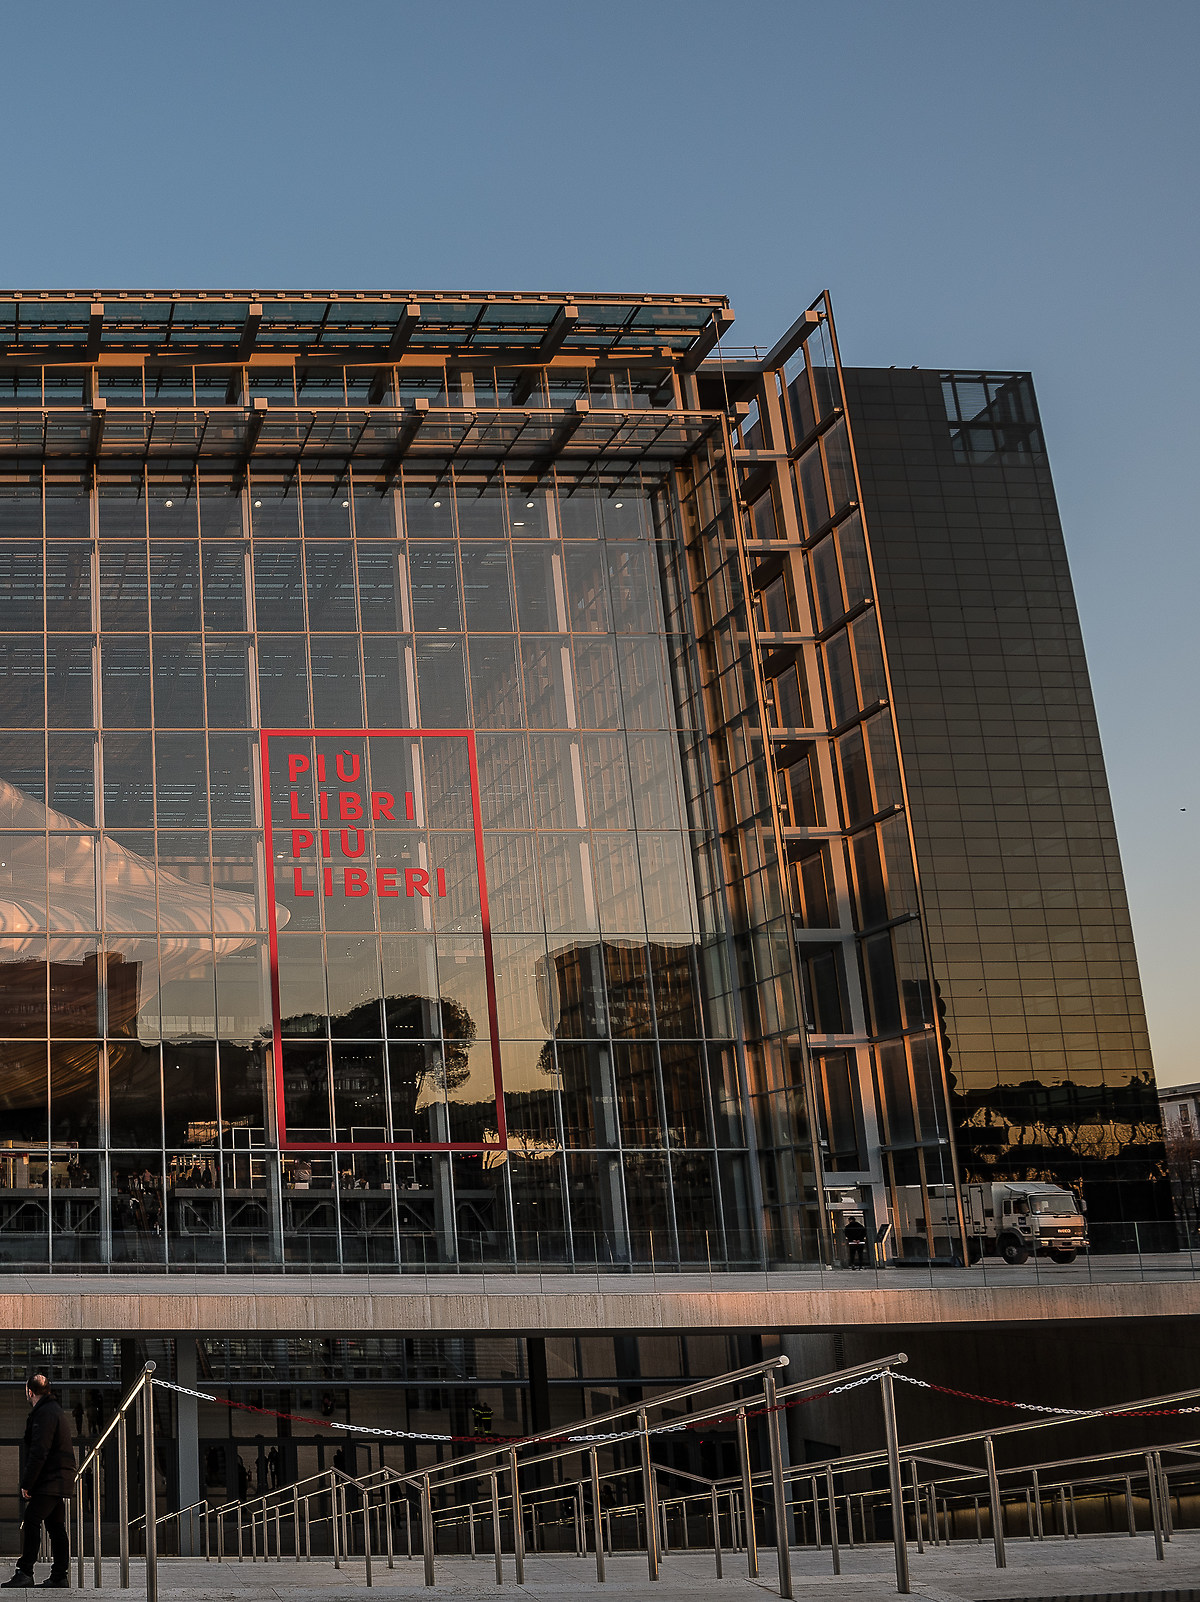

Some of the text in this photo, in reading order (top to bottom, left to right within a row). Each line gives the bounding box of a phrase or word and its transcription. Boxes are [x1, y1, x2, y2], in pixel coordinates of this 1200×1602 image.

[288, 750, 361, 783] PIÙ
[290, 791, 414, 820] LIBRI
[292, 825, 365, 858] PIÙ
[293, 867, 447, 897] LIBERI
